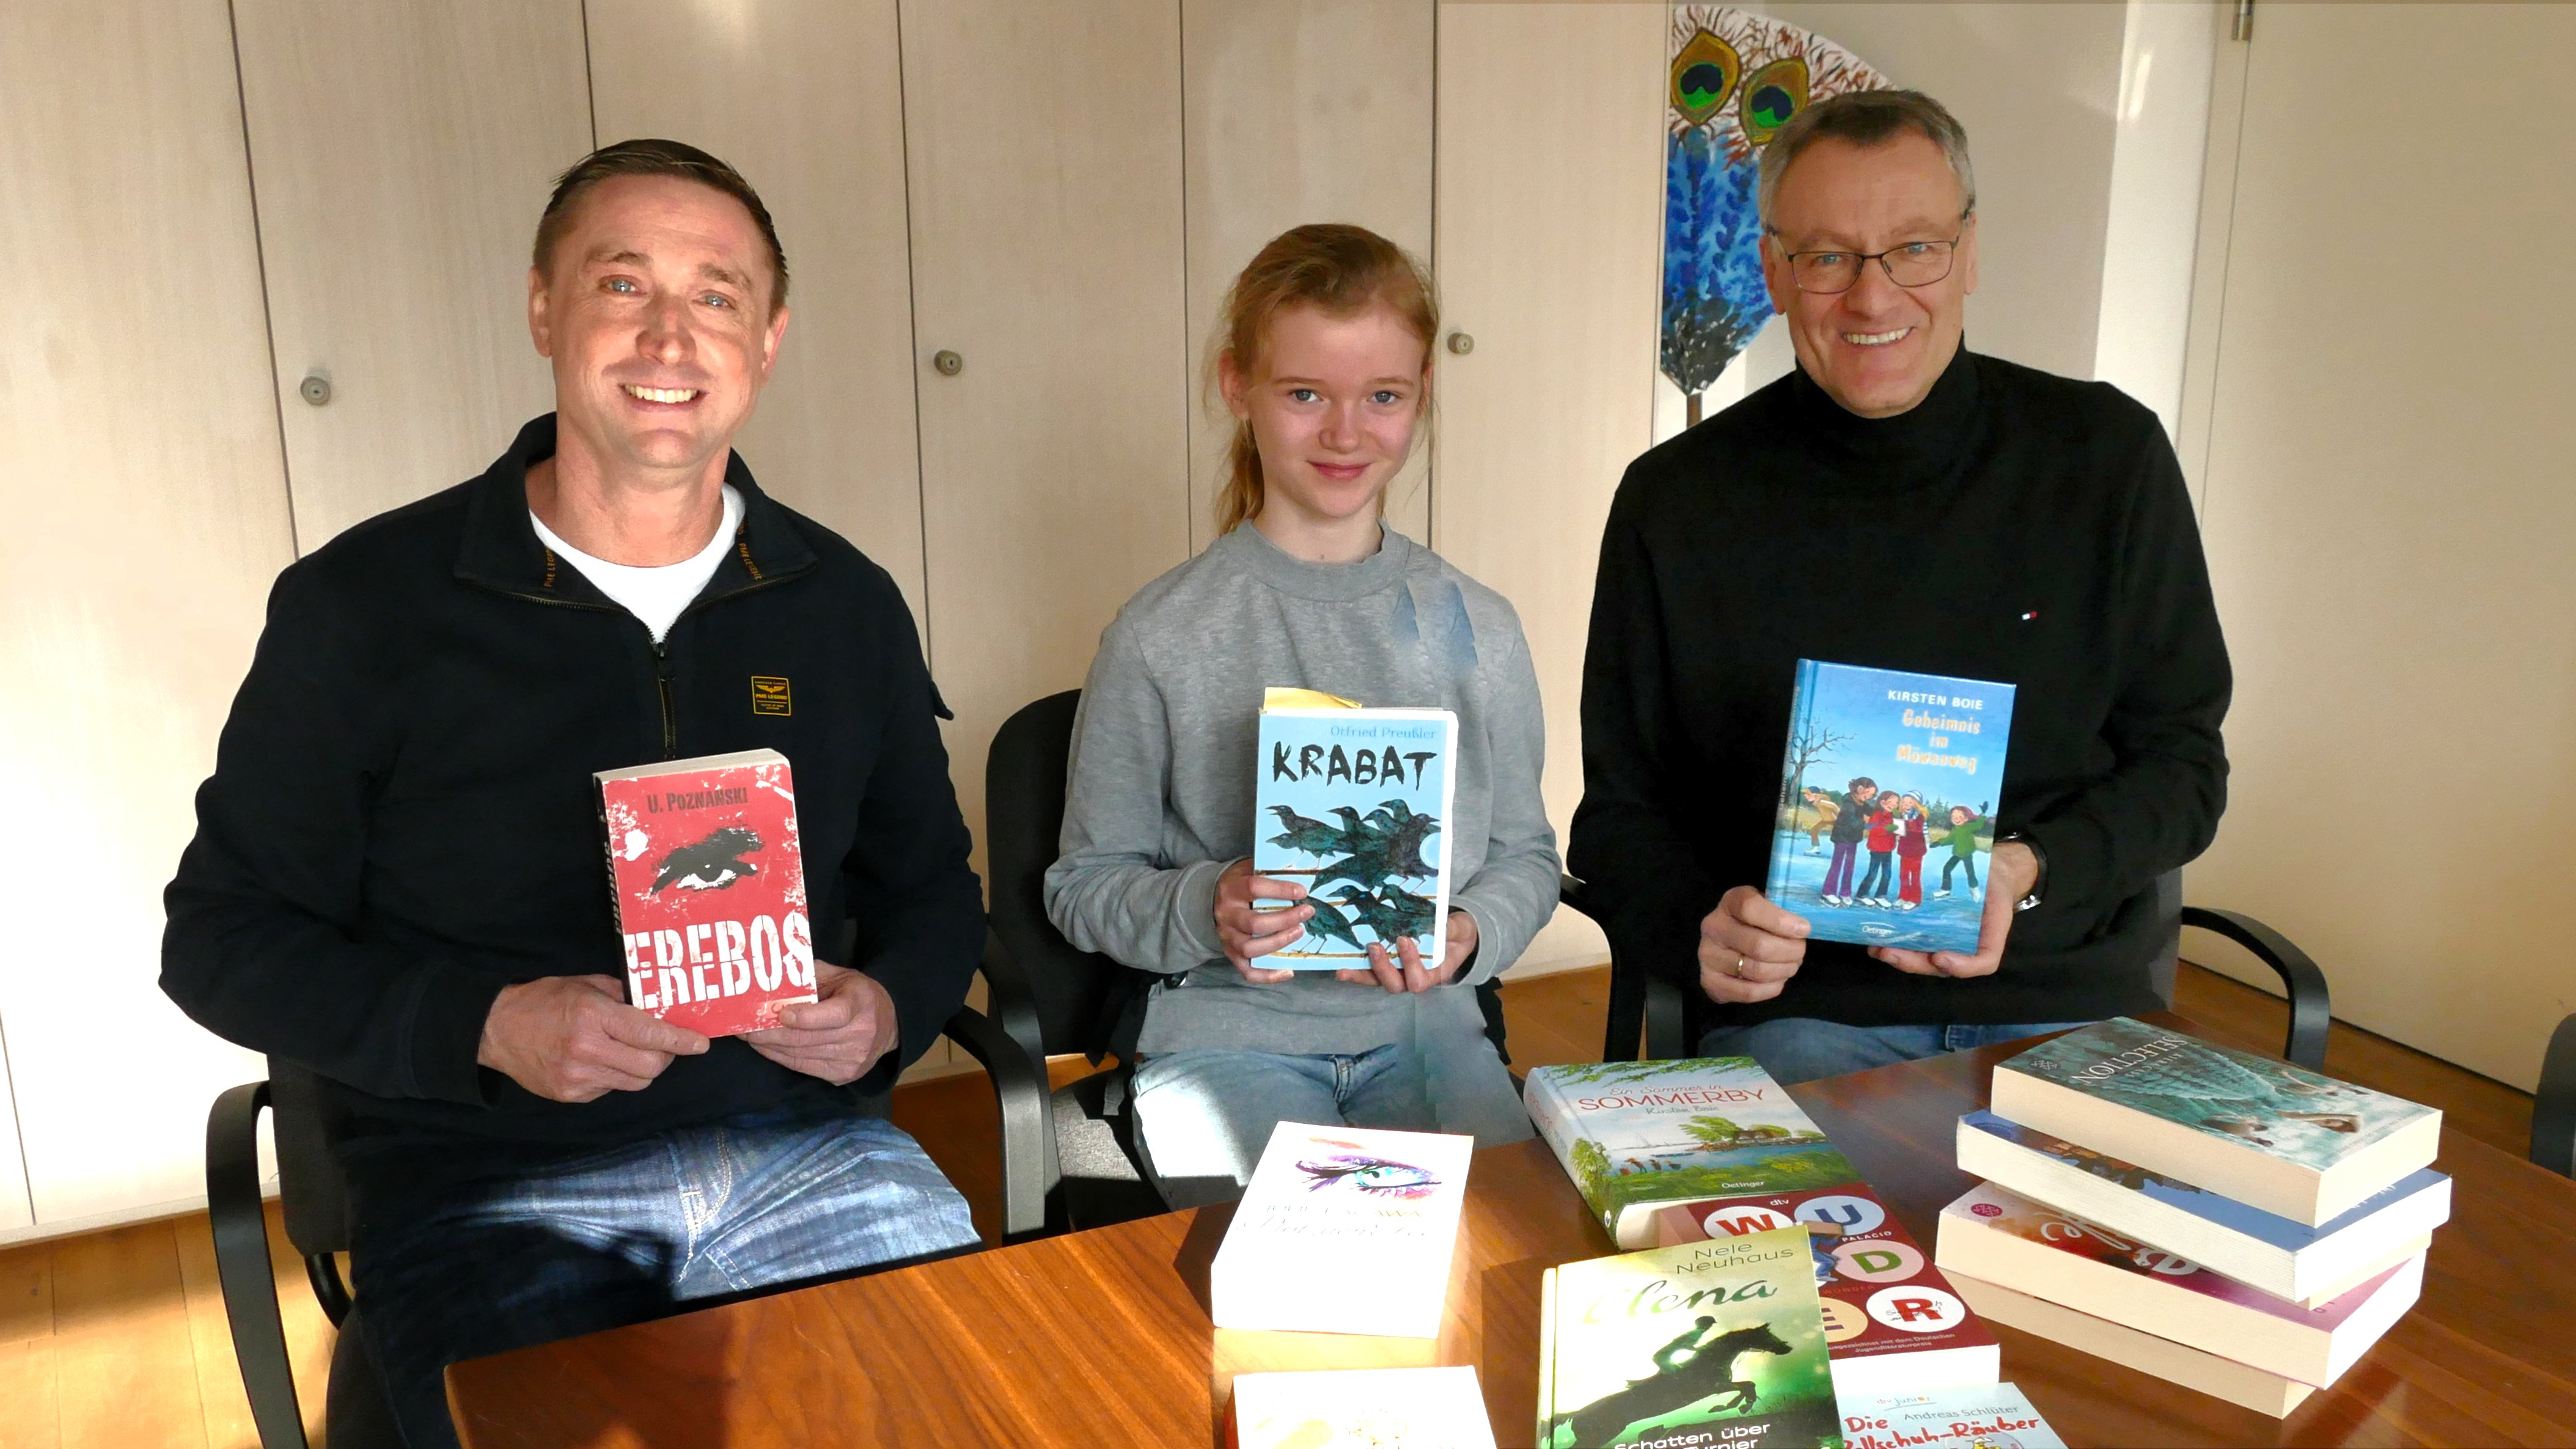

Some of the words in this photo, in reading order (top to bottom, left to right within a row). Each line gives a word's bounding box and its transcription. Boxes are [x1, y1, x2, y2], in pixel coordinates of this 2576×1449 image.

[1888, 690, 1947, 706] KIRSTEN
[1951, 697, 1984, 710] BOIE
[1903, 708, 1981, 735] Geheimnis
[1330, 725, 1376, 738] Otfried
[1382, 727, 1436, 739] Preußler
[1929, 731, 1949, 749] im
[1272, 741, 1437, 791] KRABAT
[1896, 744, 1978, 775] Möwenweg
[647, 794, 663, 814] U.
[666, 787, 748, 812] POZNANSKI
[1862, 925, 1893, 937] Oetinger
[623, 911, 815, 1010] EREBOS
[2070, 1035, 2188, 1084] SELECTION
[1578, 1089, 1764, 1111] SOMMERBY
[1610, 1087, 1632, 1096] Ein
[1640, 1085, 1702, 1094] Sommer
[1814, 1204, 1863, 1226] U
[1841, 1230, 1892, 1242] PALACIO
[1676, 1248, 1794, 1275] Neuhaus
[1695, 1244, 1753, 1260] Nele
[1850, 1250, 1903, 1274] D
[1822, 1285, 1875, 1295] WUNDER
[1890, 1298, 1943, 1322] R
[1829, 1341, 1880, 1351] usgezeichnet
[1914, 1333, 1955, 1342] Deutschen
[1855, 1342, 1932, 1354] Jugendliteraturpreis
[1904, 1409, 1959, 1421] Andreas
[1961, 1406, 2019, 1417] Schlüter
[1721, 1424, 1771, 1439] über
[1844, 1415, 1888, 1433] Die
[1844, 1417, 2039, 1449] llschuh-Räuber
[1684, 1439, 1758, 1449] rnier
